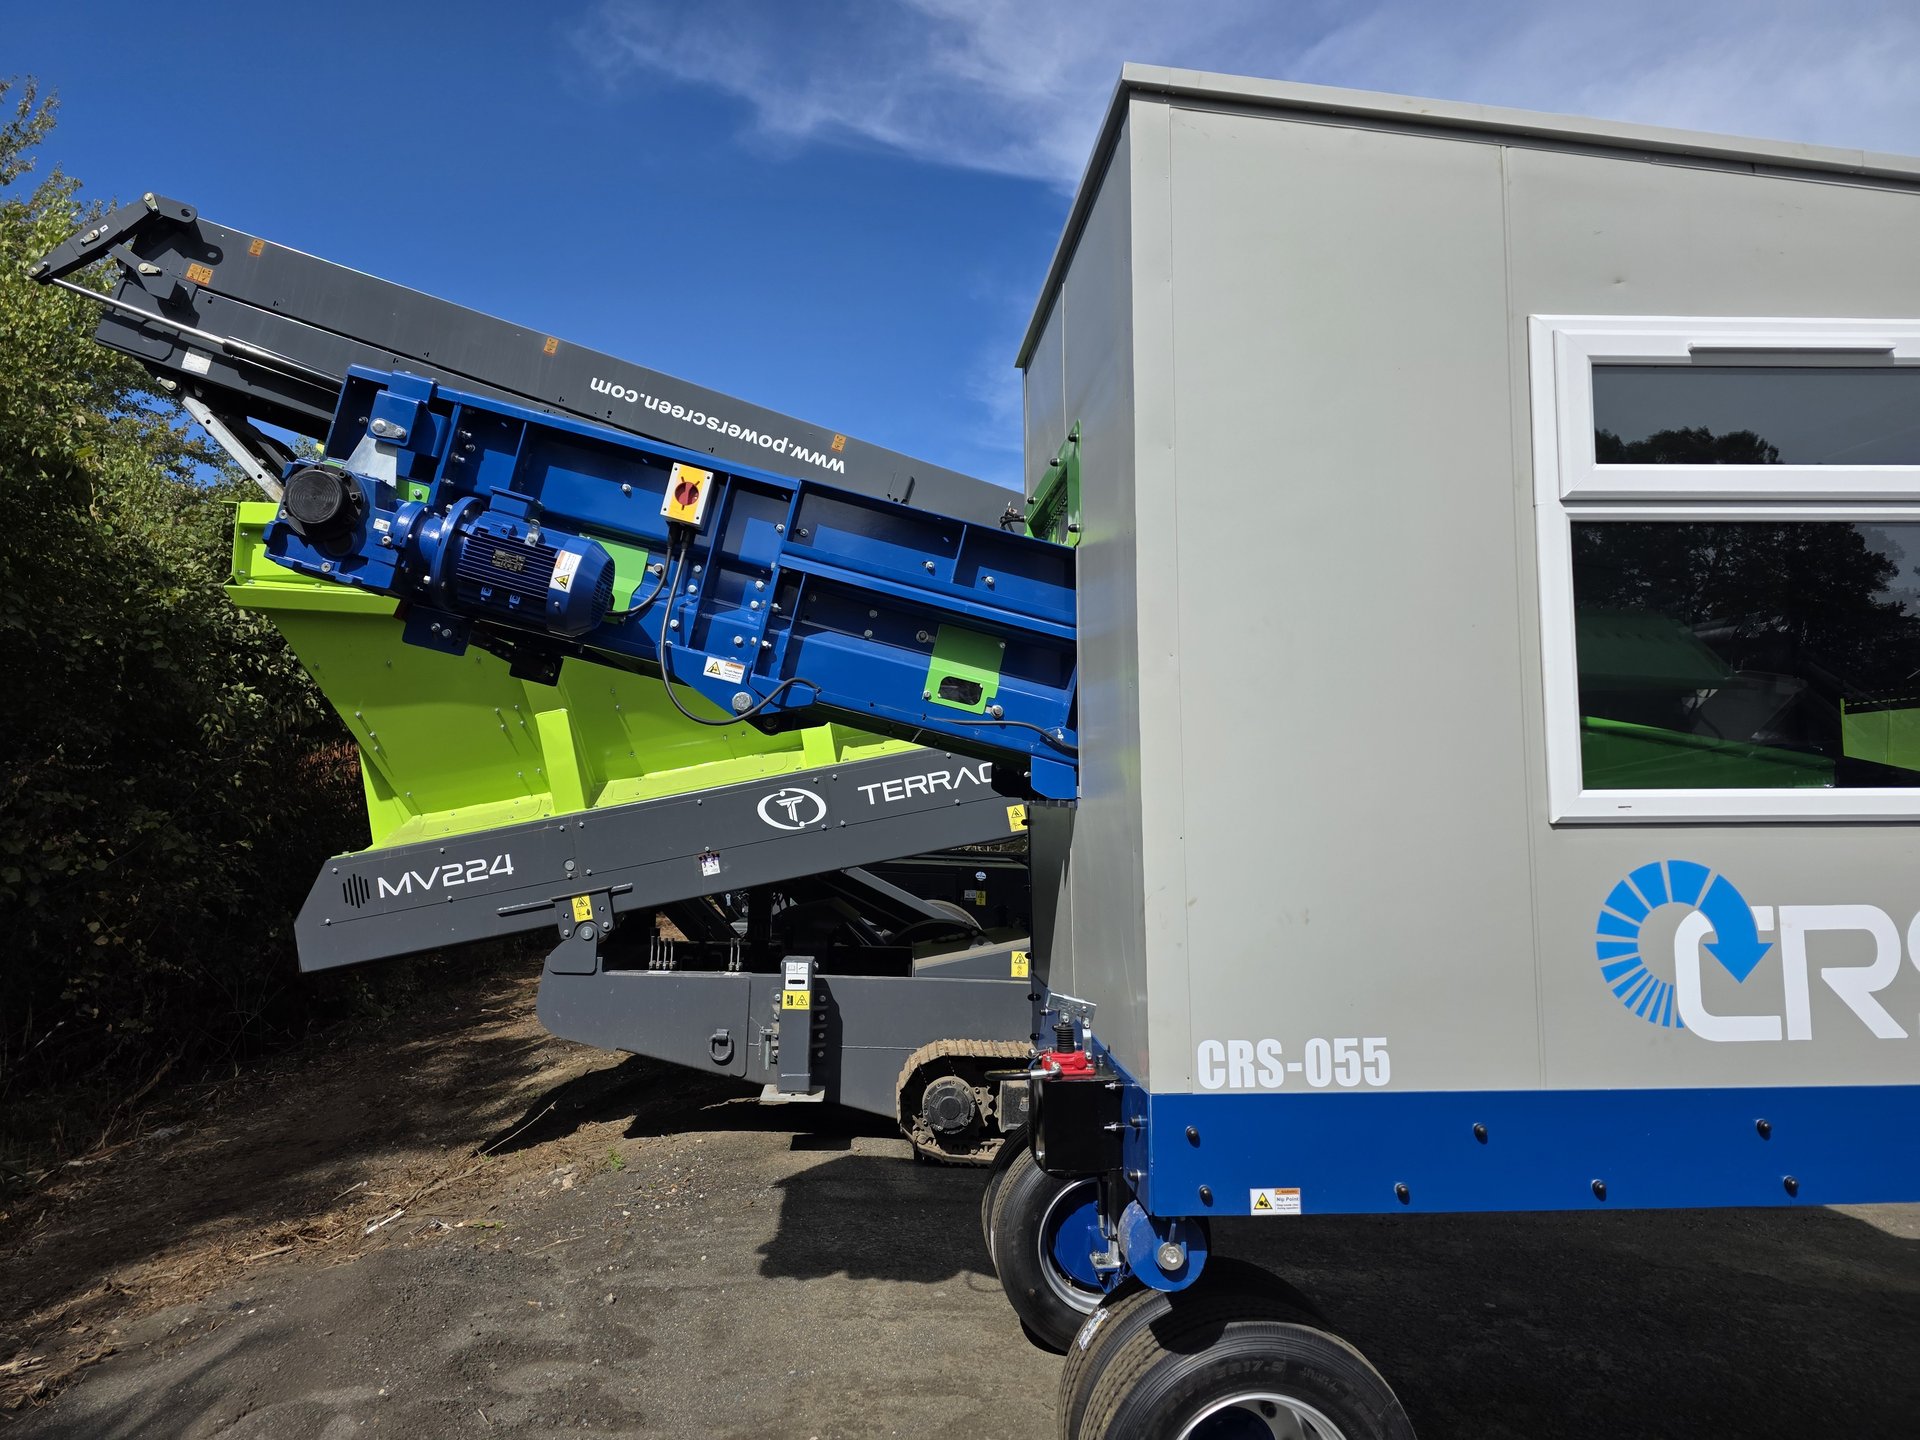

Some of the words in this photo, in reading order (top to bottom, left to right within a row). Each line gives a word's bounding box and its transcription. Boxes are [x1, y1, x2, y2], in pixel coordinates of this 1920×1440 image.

[589, 377, 847, 475] www.powerscreen.com
[376, 853, 516, 899] MV224
[1673, 904, 1920, 1042] CR
[1197, 1036, 1392, 1090] CRS-055
